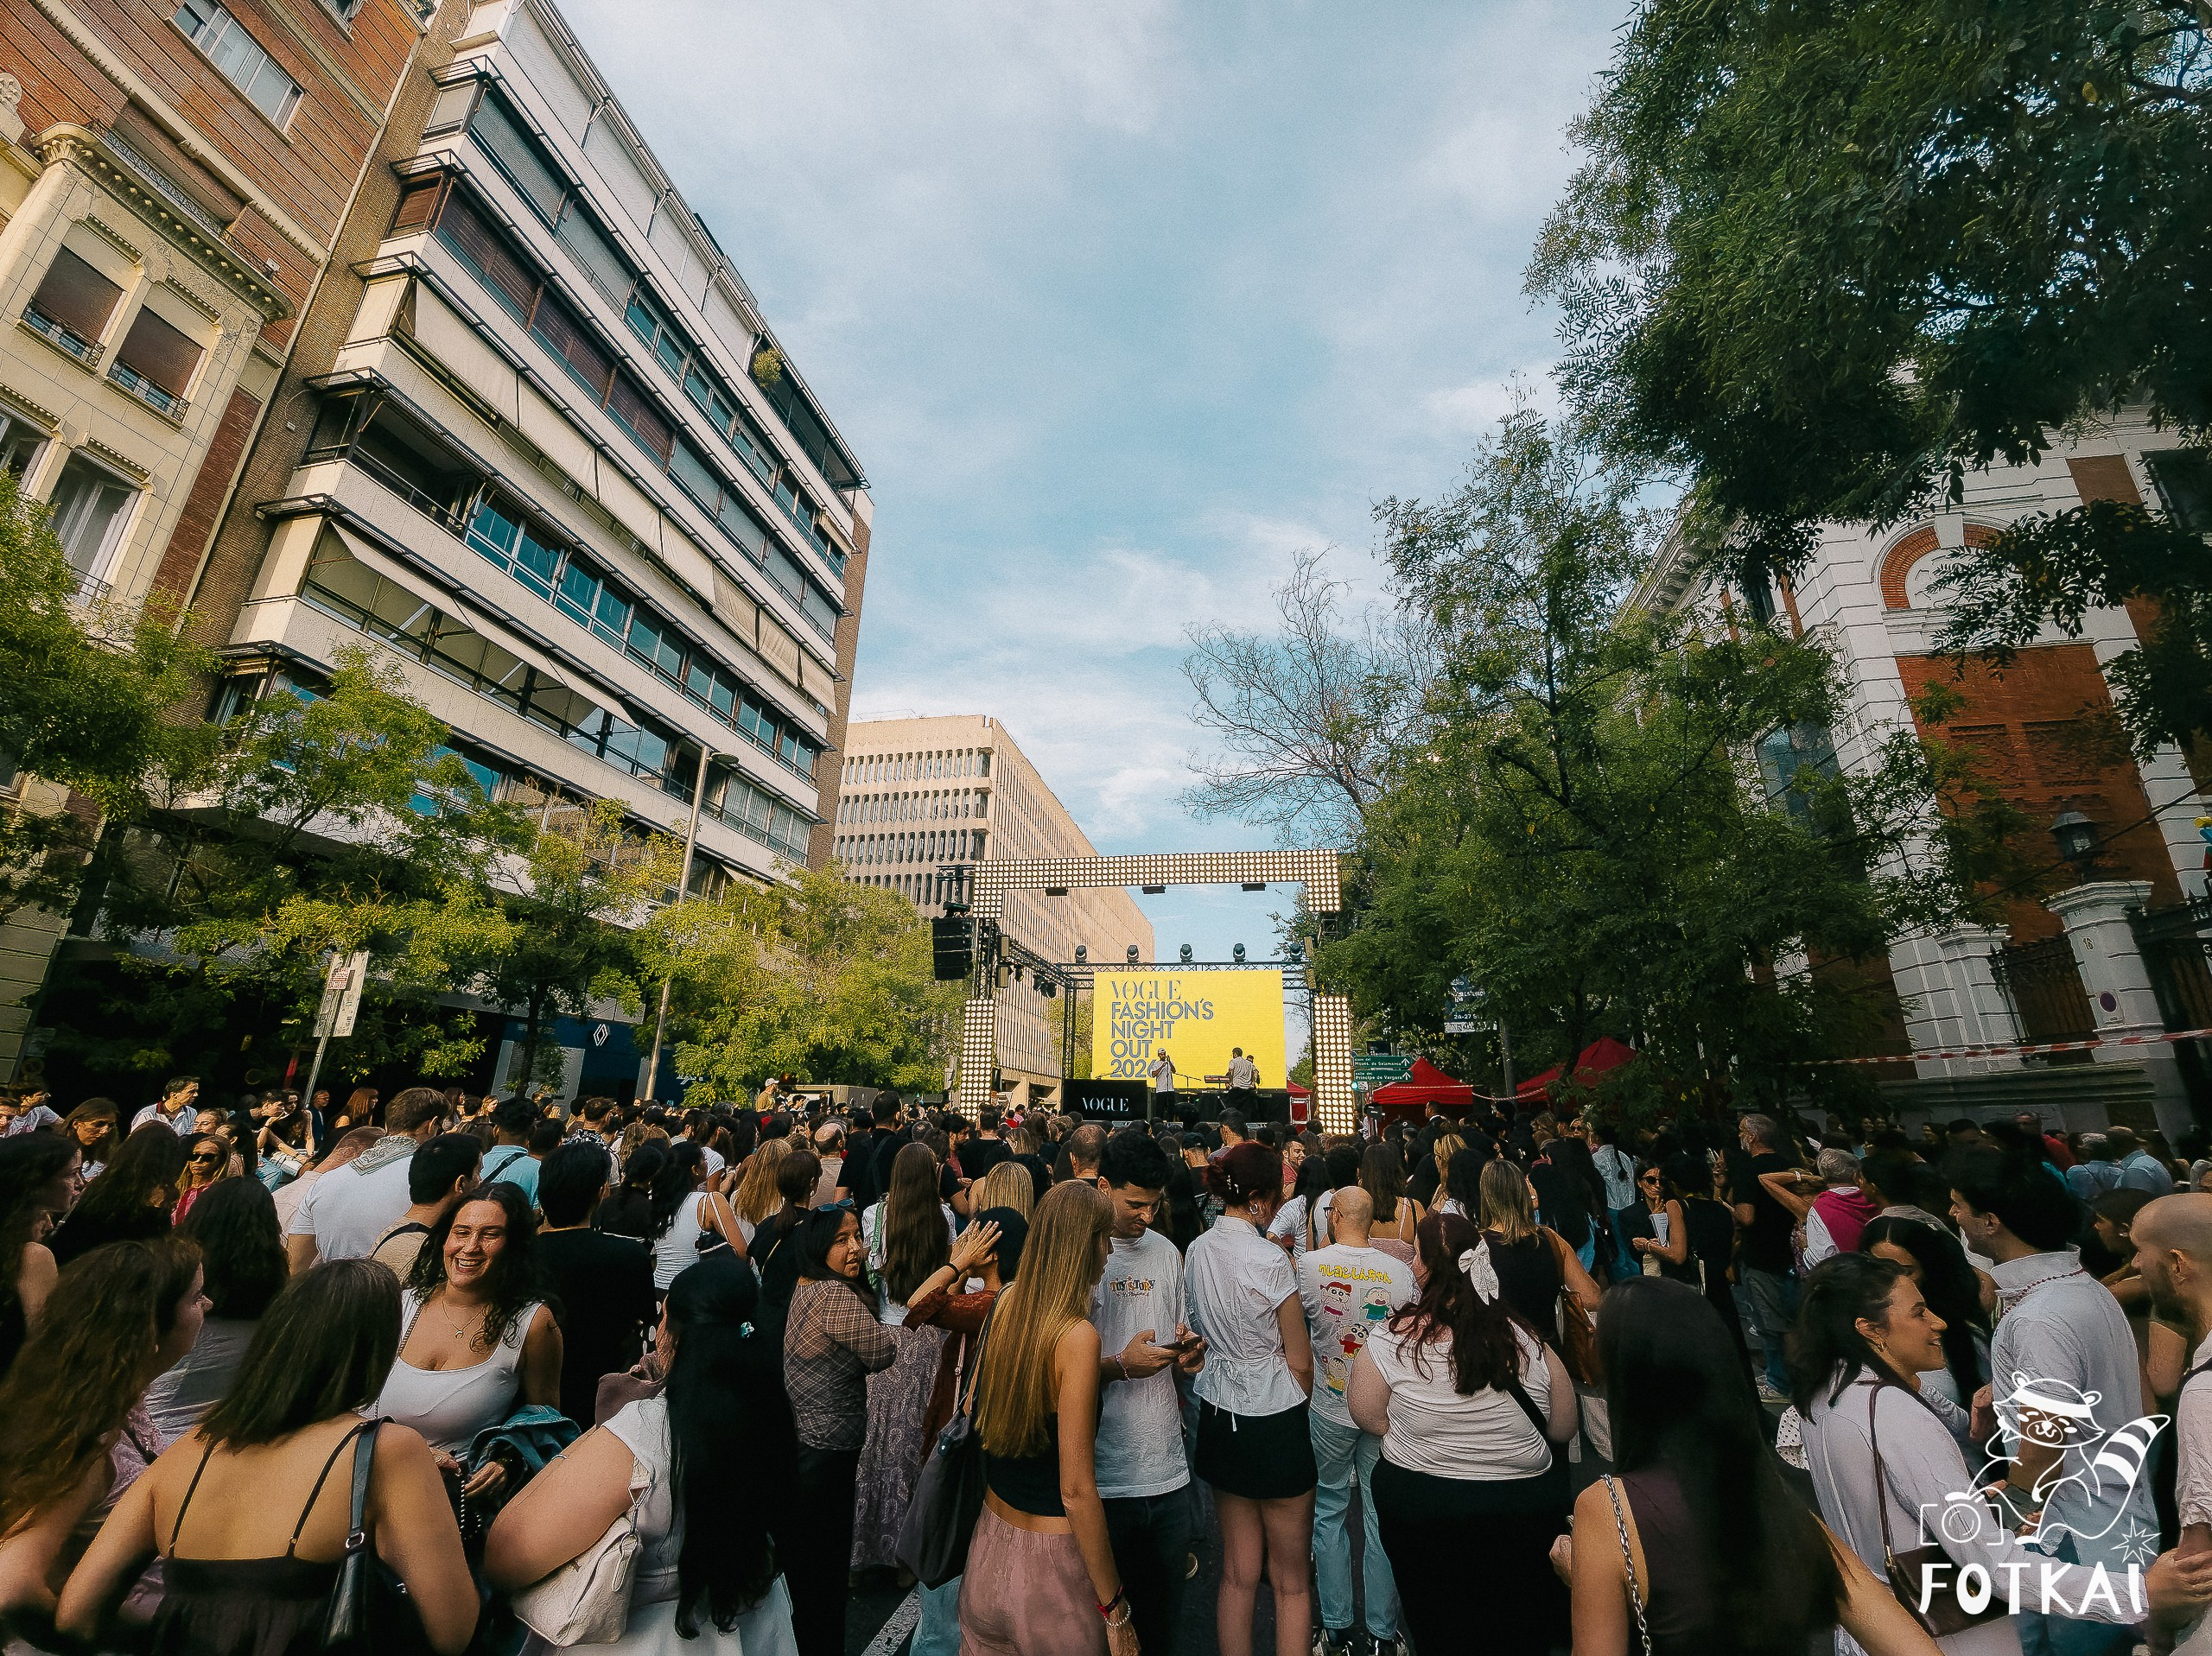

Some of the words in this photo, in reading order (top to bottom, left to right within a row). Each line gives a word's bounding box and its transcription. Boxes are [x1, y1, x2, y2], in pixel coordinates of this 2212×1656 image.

[1111, 980, 1181, 999] VOGUE
[1111, 998, 1214, 1020] FASHION'S
[1111, 1020, 1175, 1039] NIGHT
[1110, 1039, 1153, 1058] OUT
[1082, 1097, 1129, 1112] VOGUE
[1319, 1264, 1392, 1284] クレヨンしんちゃん
